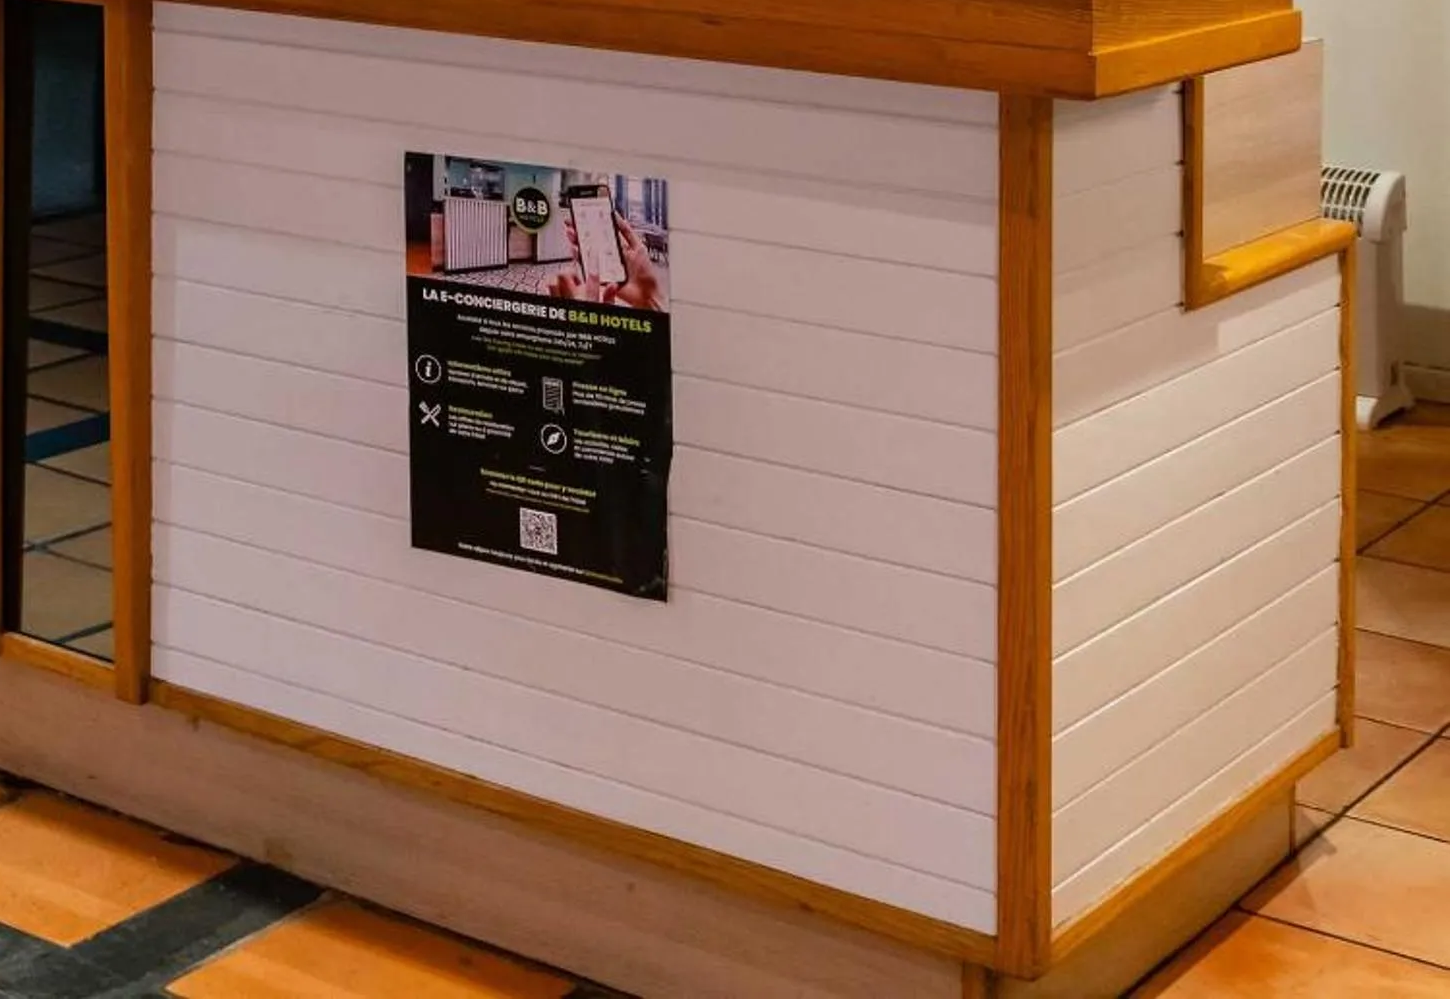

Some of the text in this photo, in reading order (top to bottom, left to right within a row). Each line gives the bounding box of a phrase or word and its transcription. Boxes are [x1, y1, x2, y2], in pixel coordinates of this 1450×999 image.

[516, 197, 548, 216] B&B
[422, 287, 652, 334] LA E-CONCIERGERIE DE B&B HOTELS
